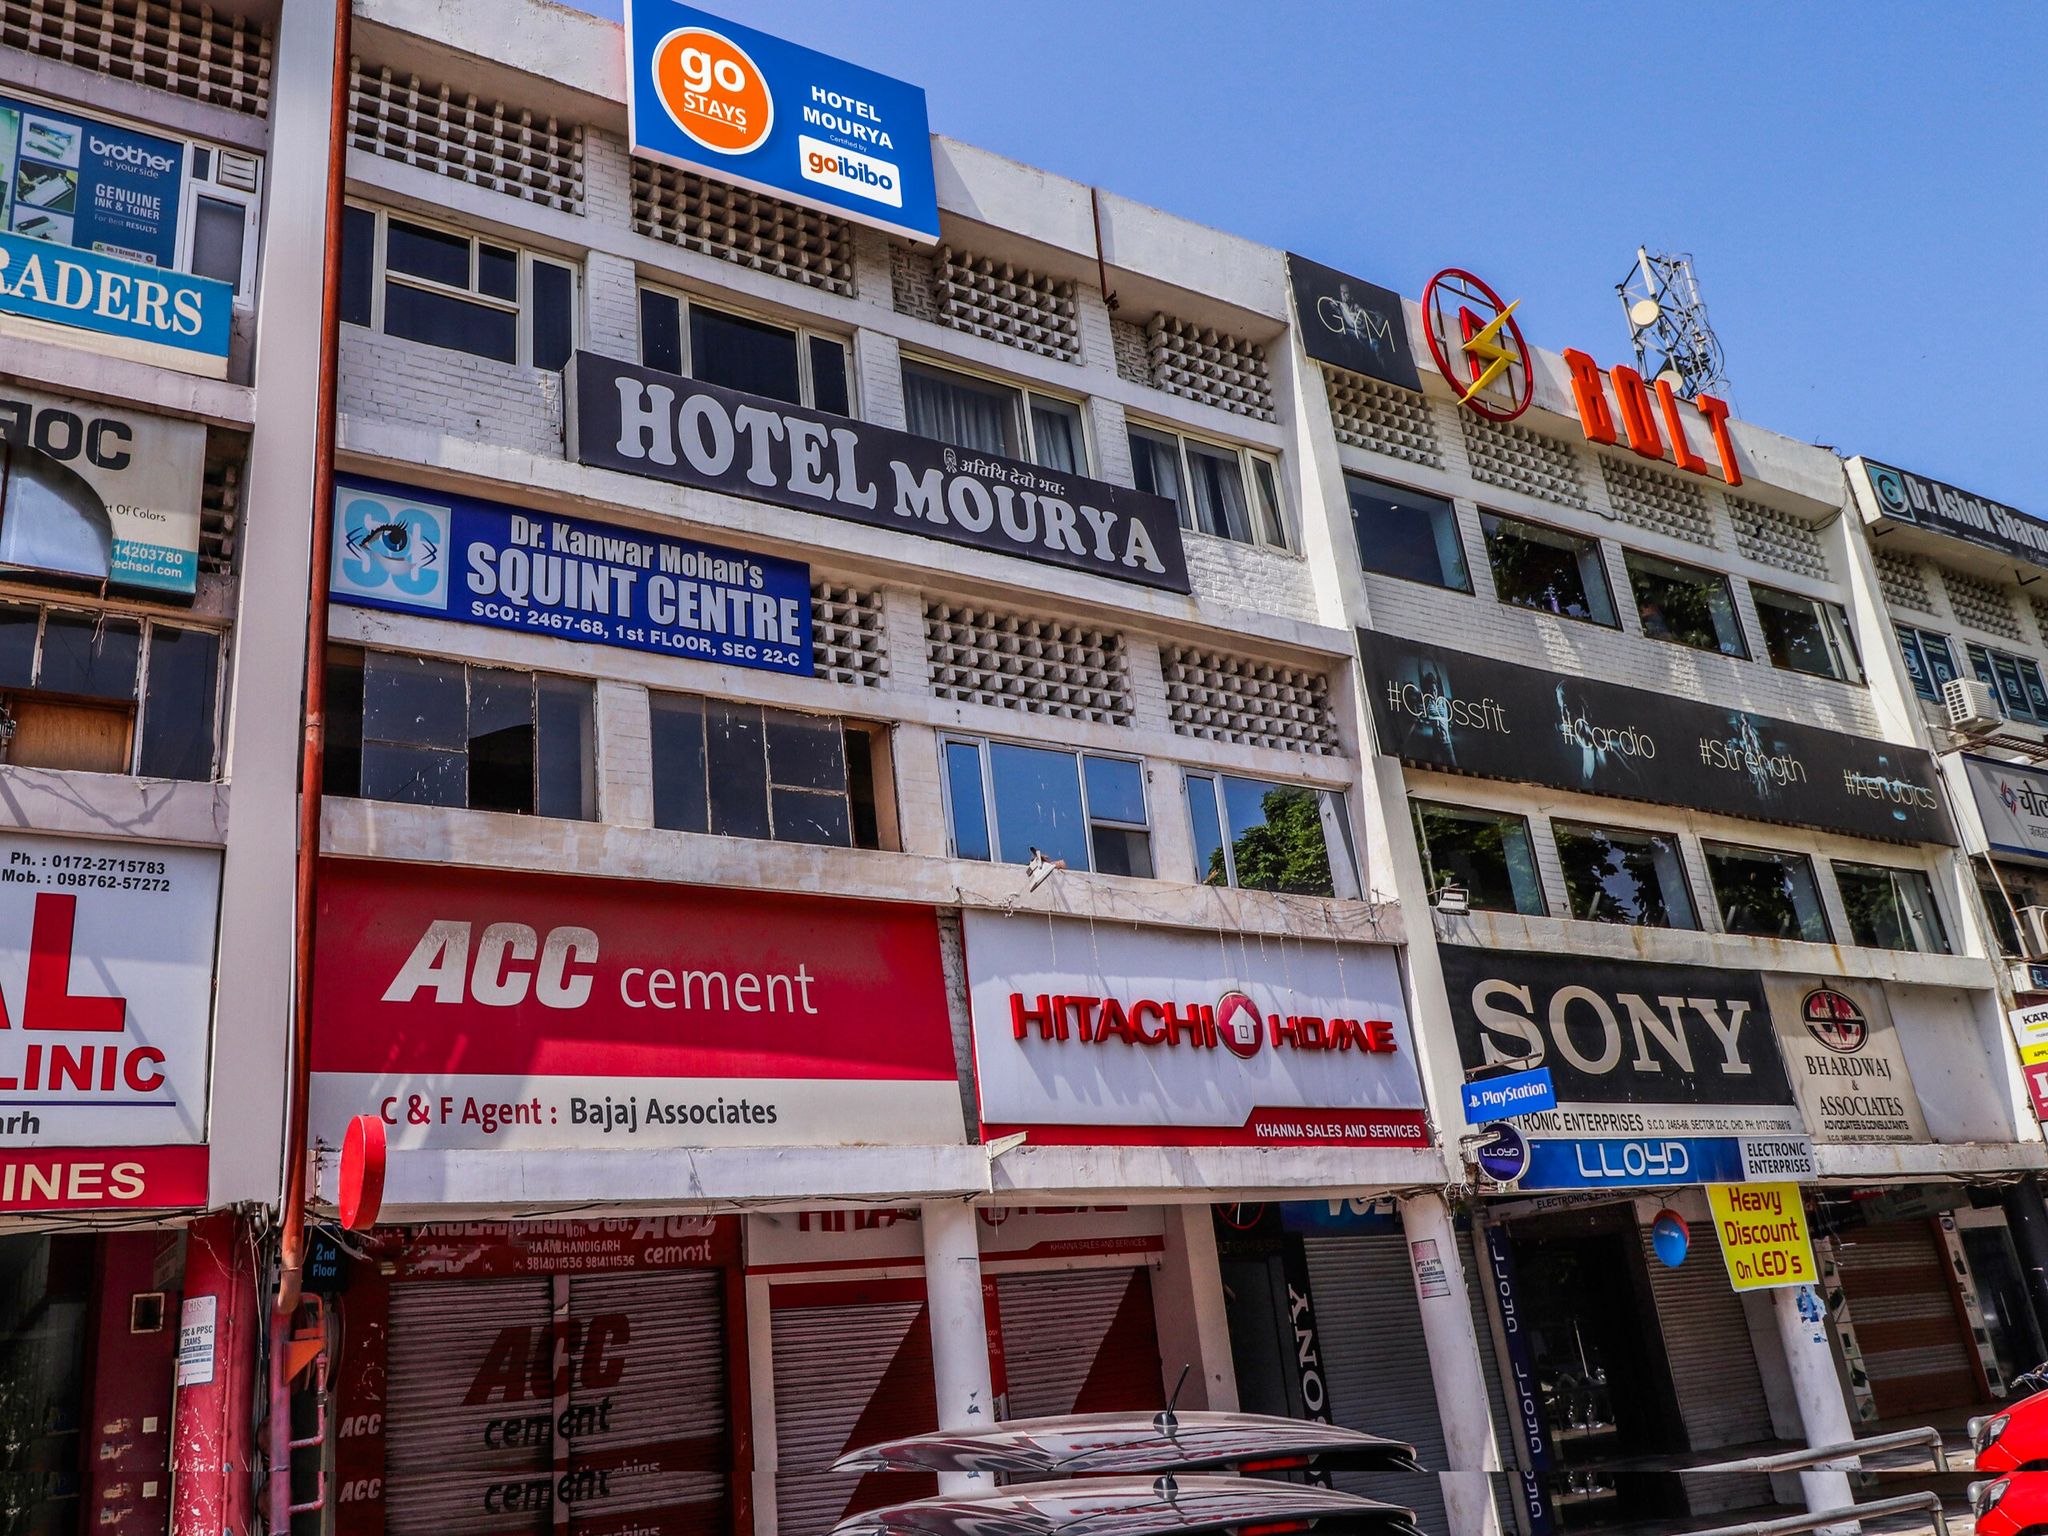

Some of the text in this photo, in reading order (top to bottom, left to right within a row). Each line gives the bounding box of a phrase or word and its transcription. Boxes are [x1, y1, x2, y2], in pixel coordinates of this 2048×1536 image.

[680, 47, 746, 93] go
[683, 92, 747, 125] STAYS
[810, 86, 882, 123] HOTEL
[802, 105, 894, 150] MOURYA
[829, 134, 868, 153] Certified by
[89, 136, 174, 172] brother
[103, 159, 159, 179] at your side
[808, 151, 893, 191] goibibo
[94, 197, 160, 220] INK & TONER
[95, 183, 161, 211] GENUINE
[125, 221, 158, 234] RESULTS
[1316, 296, 1396, 353] GYM
[614, 376, 877, 510] HOTEL
[960, 458, 1007, 481] अतिथि
[1010, 467, 1036, 488] देवो
[116, 504, 131, 516] Of
[133, 506, 166, 522] Colors
[893, 459, 1166, 575] MOURYA
[1902, 473, 1937, 515] Dr.
[1932, 482, 1997, 535] Ashok
[1990, 504, 2048, 553] Sharm
[509, 515, 764, 590] Dr. Kanwar Mohan's
[465, 540, 802, 648] SQUINT CENTRE
[470, 600, 801, 668] SCO: 2467-68, 1st FLOOR, SEC 22-C
[1387, 680, 1511, 735] #Crossfit
[1561, 717, 1657, 761] #Cardio
[1699, 736, 1807, 783] #Strength
[1, 868, 42, 885] Mob.
[56, 872, 171, 892] 098762-57272
[10, 852, 37, 867] Ph.
[52, 854, 166, 875] 0172-2715783
[0, 892, 127, 1032] L
[381, 918, 819, 1015] ACC cement
[1009, 992, 1398, 1054] HITACHI HOME
[1470, 978, 1753, 1076] SONY
[1804, 1055, 1892, 1081] BHARDWAJ
[1482, 1083, 1548, 1107] PlayStation
[1851, 1080, 1860, 1091] &
[380, 1096, 399, 1126] C
[406, 1094, 432, 1126] &
[439, 1097, 455, 1126] F
[460, 1096, 543, 1133] Agent
[570, 1095, 639, 1134] Bajaj
[644, 1095, 778, 1126] Associates
[1566, 1113, 1644, 1132] ENTERPRISES
[1691, 1119, 1714, 1130] SECTOR
[1819, 1095, 1904, 1117] ASSOCIATES
[1255, 1123, 1421, 1139] KHANNA SALES AND SERVICES
[1482, 1147, 1520, 1157] LLOYD
[1575, 1142, 1689, 1178] LLOYD
[1747, 1142, 1807, 1158] ELECTRONIC
[1748, 1159, 1811, 1175] ENTERPRISES
[1730, 1188, 1782, 1216] Heavy
[1724, 1217, 1800, 1247] Discount
[316, 1243, 336, 1260] 2nd
[1736, 1250, 1803, 1280] On LED's
[313, 1263, 337, 1277] Floor
[1492, 1244, 1518, 1334] LLOYD
[459, 1311, 632, 1407] ACC
[1288, 1283, 1327, 1425] ONY
[484, 1396, 613, 1450] cement
[1515, 1361, 1542, 1454] LLOYD
[339, 1413, 382, 1438] ACC
[339, 1478, 382, 1503] ACC
